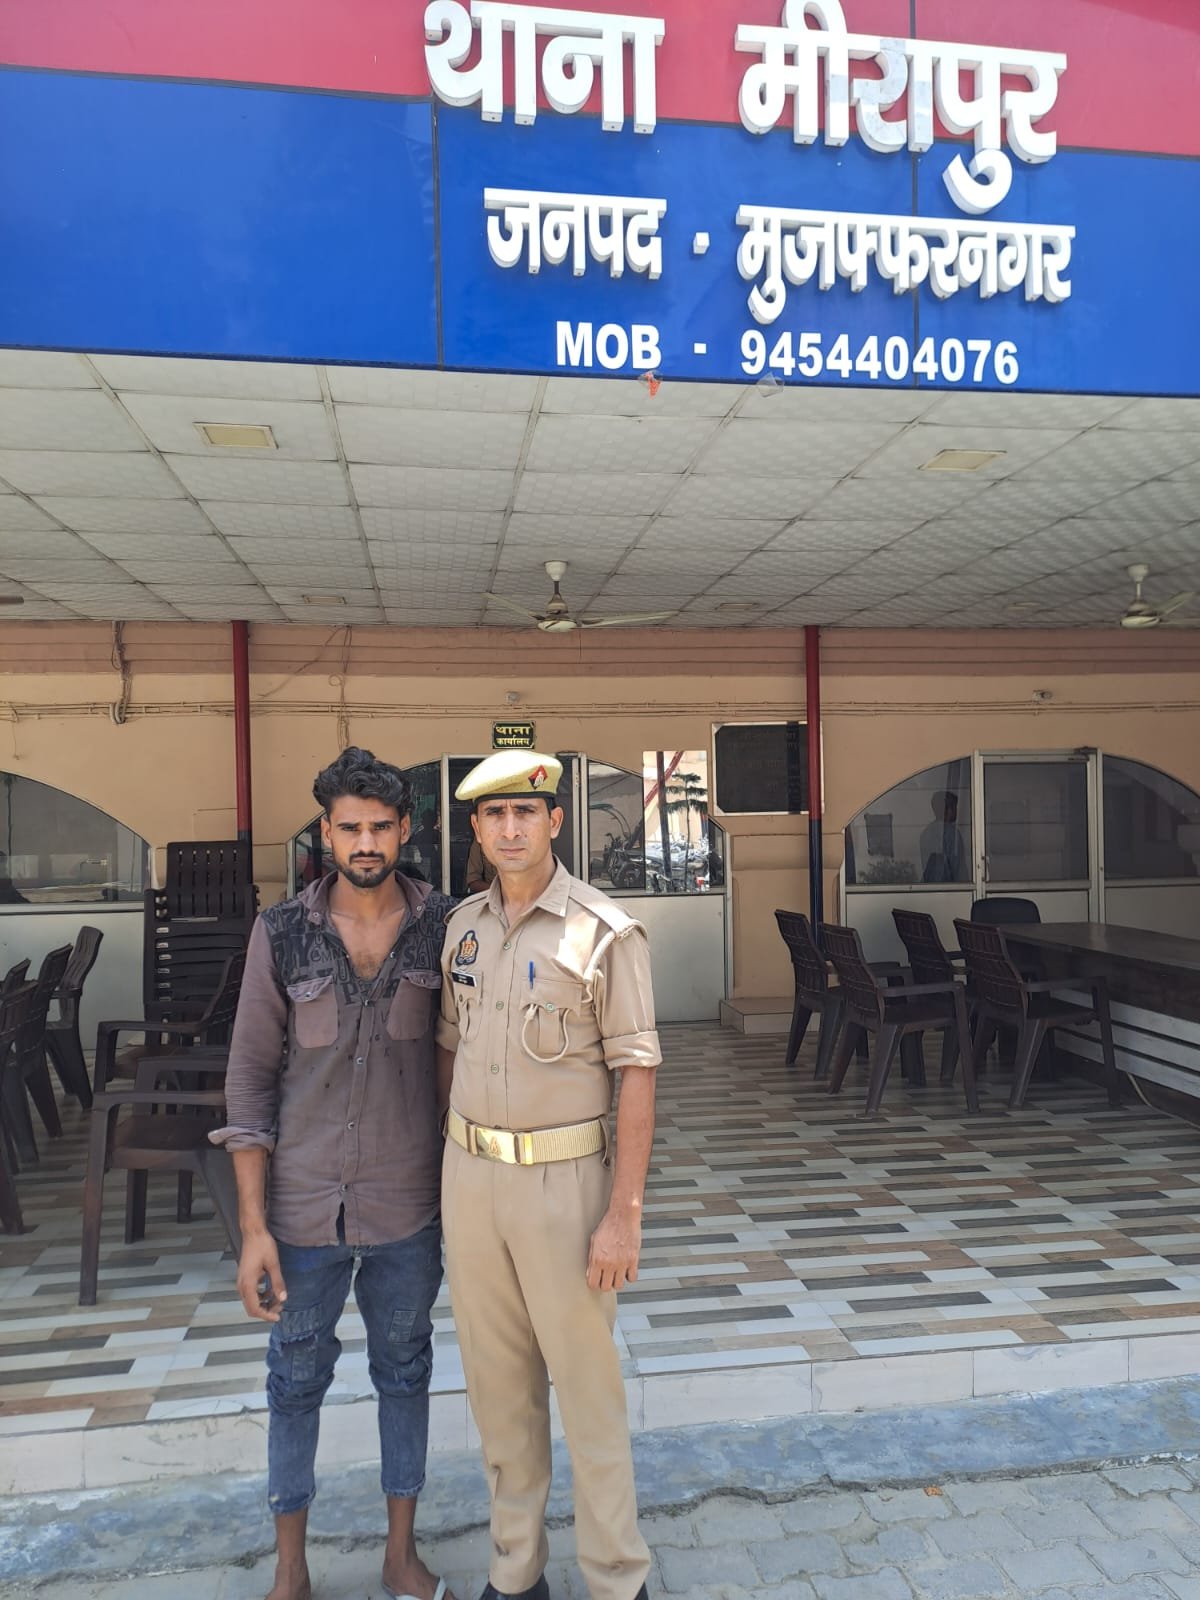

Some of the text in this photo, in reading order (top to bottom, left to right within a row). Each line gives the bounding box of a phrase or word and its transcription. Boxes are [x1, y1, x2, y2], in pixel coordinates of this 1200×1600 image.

[424, 0, 1067, 215] थाना मीरापुर
[484, 187, 667, 280] जनपद
[735, 204, 1076, 325] मुजफ्फरनगर
[556, 320, 662, 370] MOB
[740, 329, 1020, 384] 9454404076
[495, 726, 531, 735] थाना
